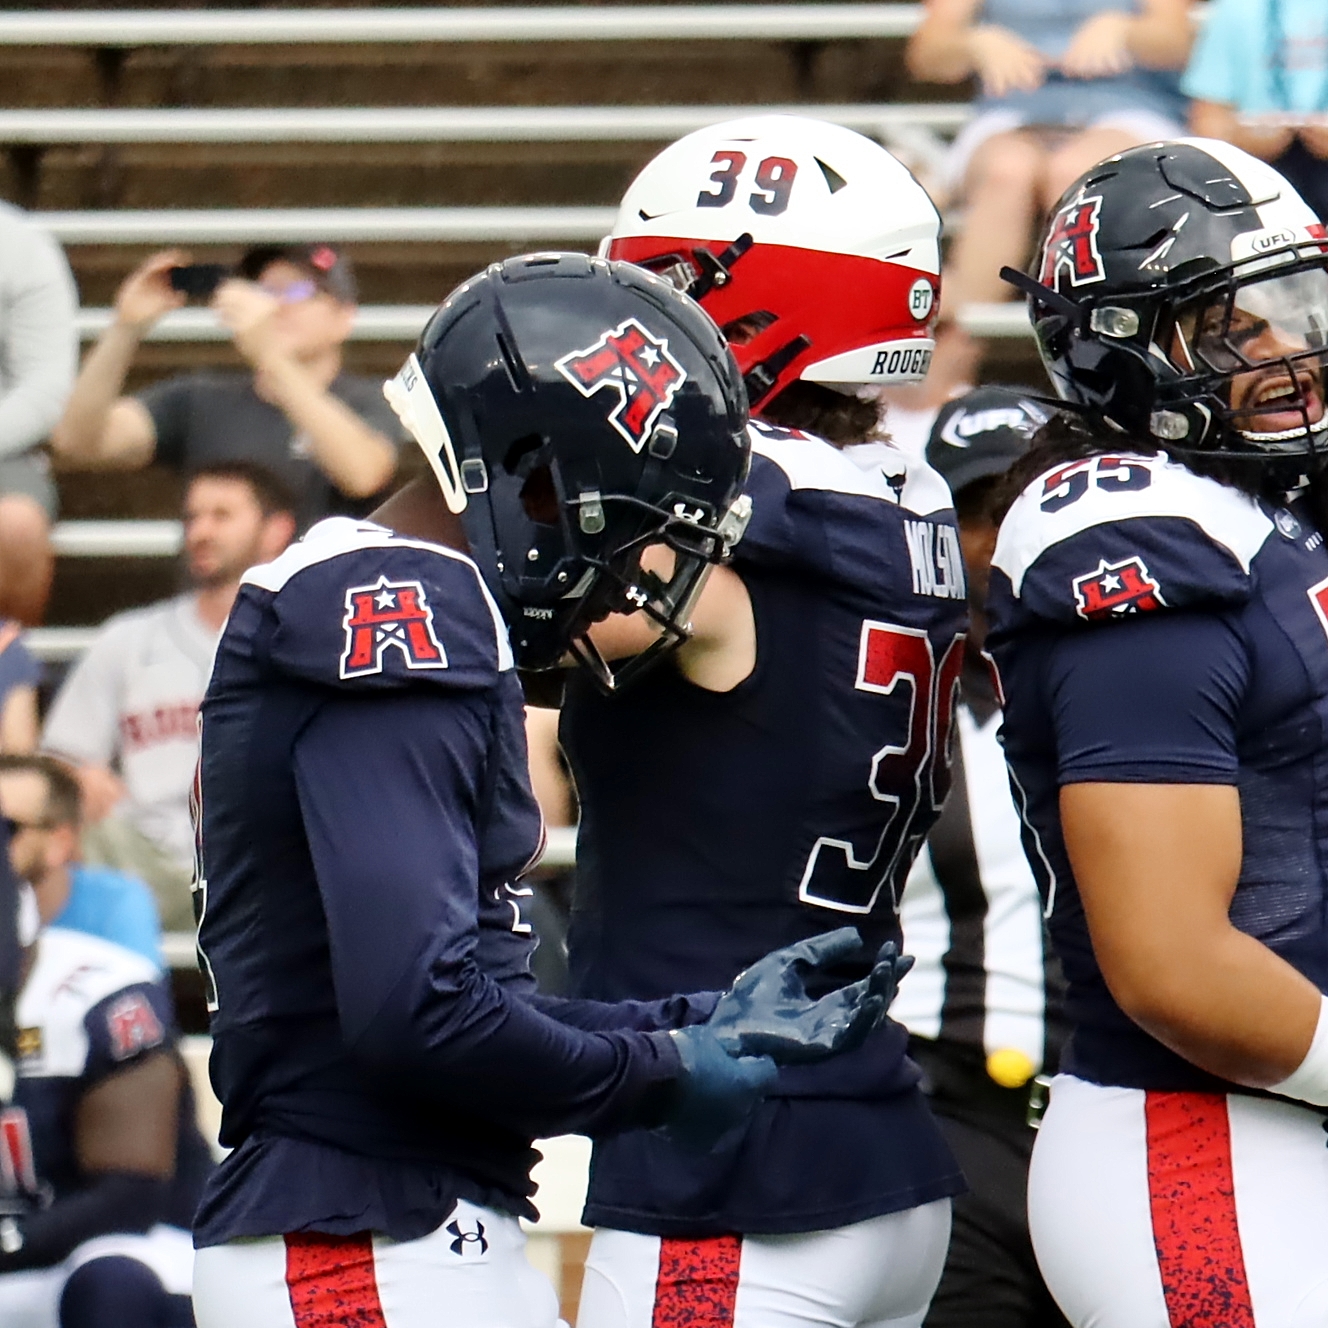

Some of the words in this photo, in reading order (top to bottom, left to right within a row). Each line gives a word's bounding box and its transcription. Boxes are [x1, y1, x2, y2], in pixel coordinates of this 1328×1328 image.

[696, 150, 799, 217] 39
[1260, 233, 1291, 249] UFL
[911, 289, 931, 309] BT
[1040, 456, 1152, 514] 55
